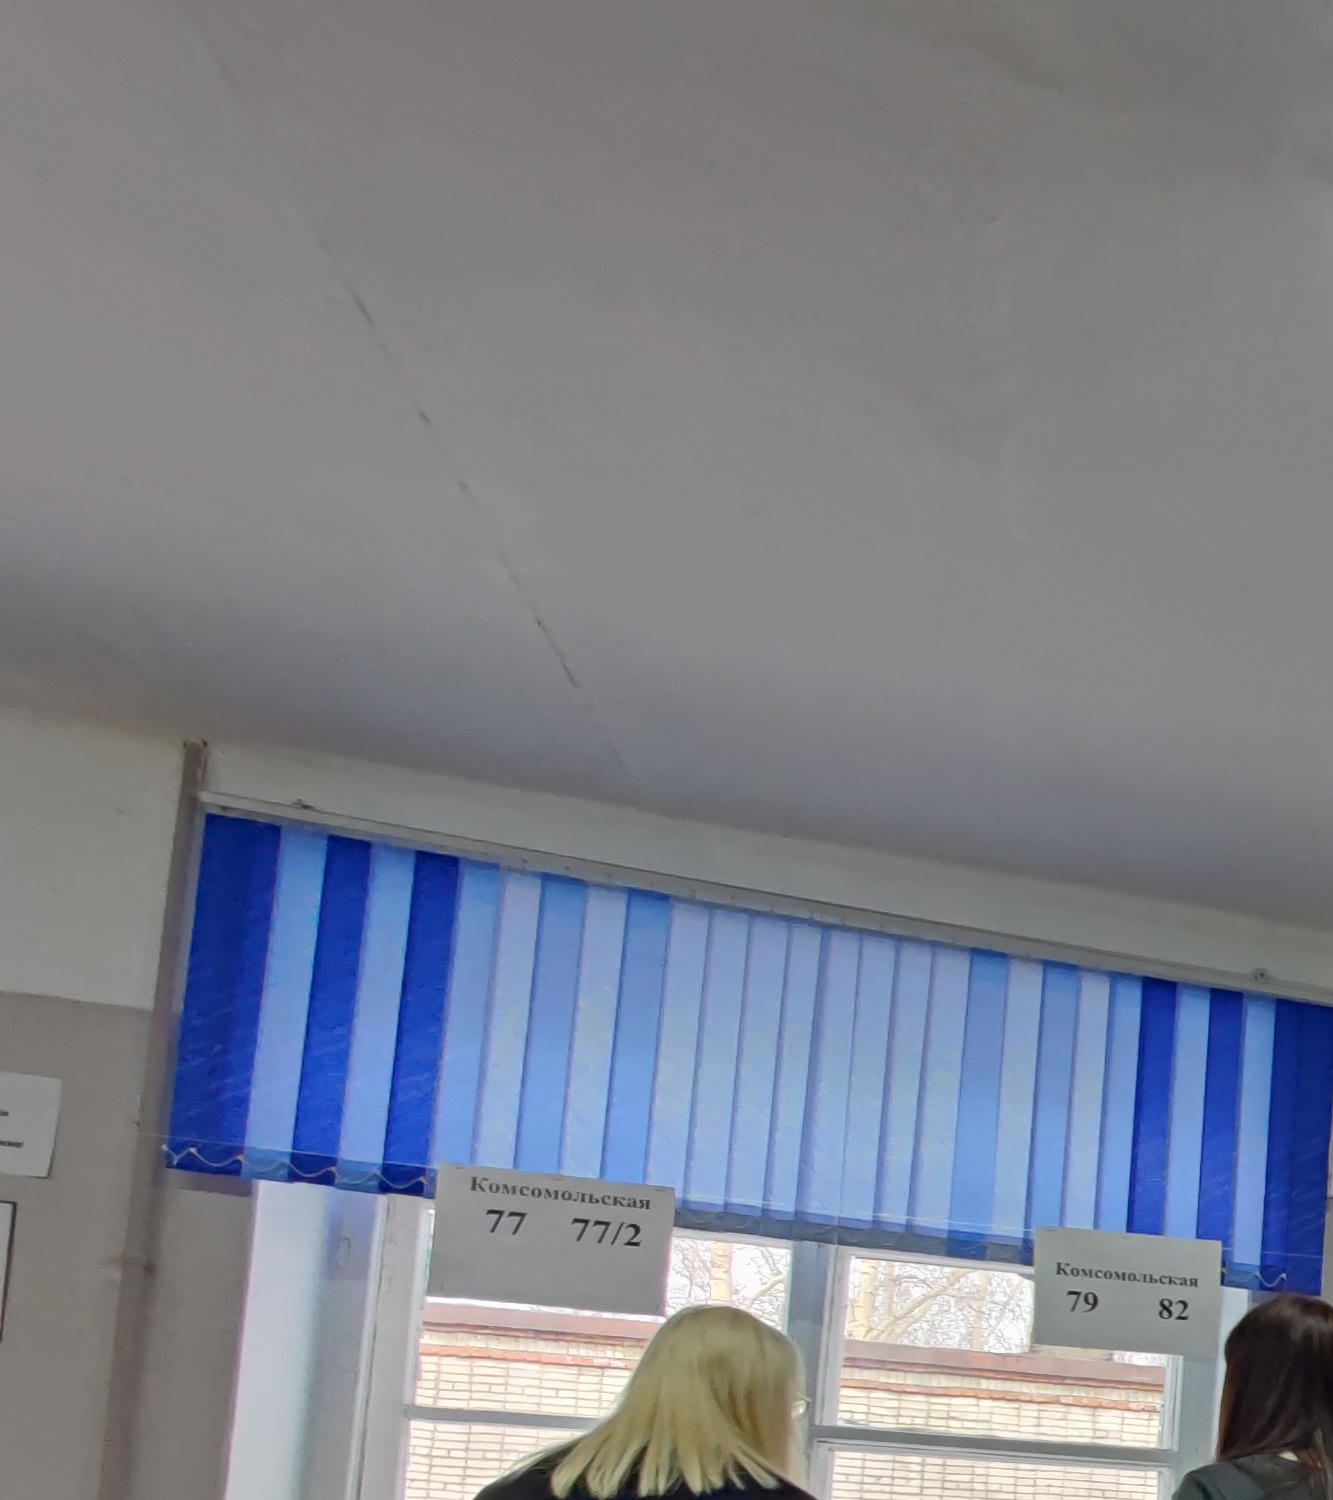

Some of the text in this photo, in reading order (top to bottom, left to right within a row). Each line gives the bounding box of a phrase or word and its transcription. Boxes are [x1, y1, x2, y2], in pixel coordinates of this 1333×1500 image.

[470, 1176, 651, 1210] Комсомольская
[486, 1209, 643, 1247] 77 77/2
[1055, 1261, 1199, 1288] Комсомольская
[1066, 1290, 1190, 1321] 79 82
